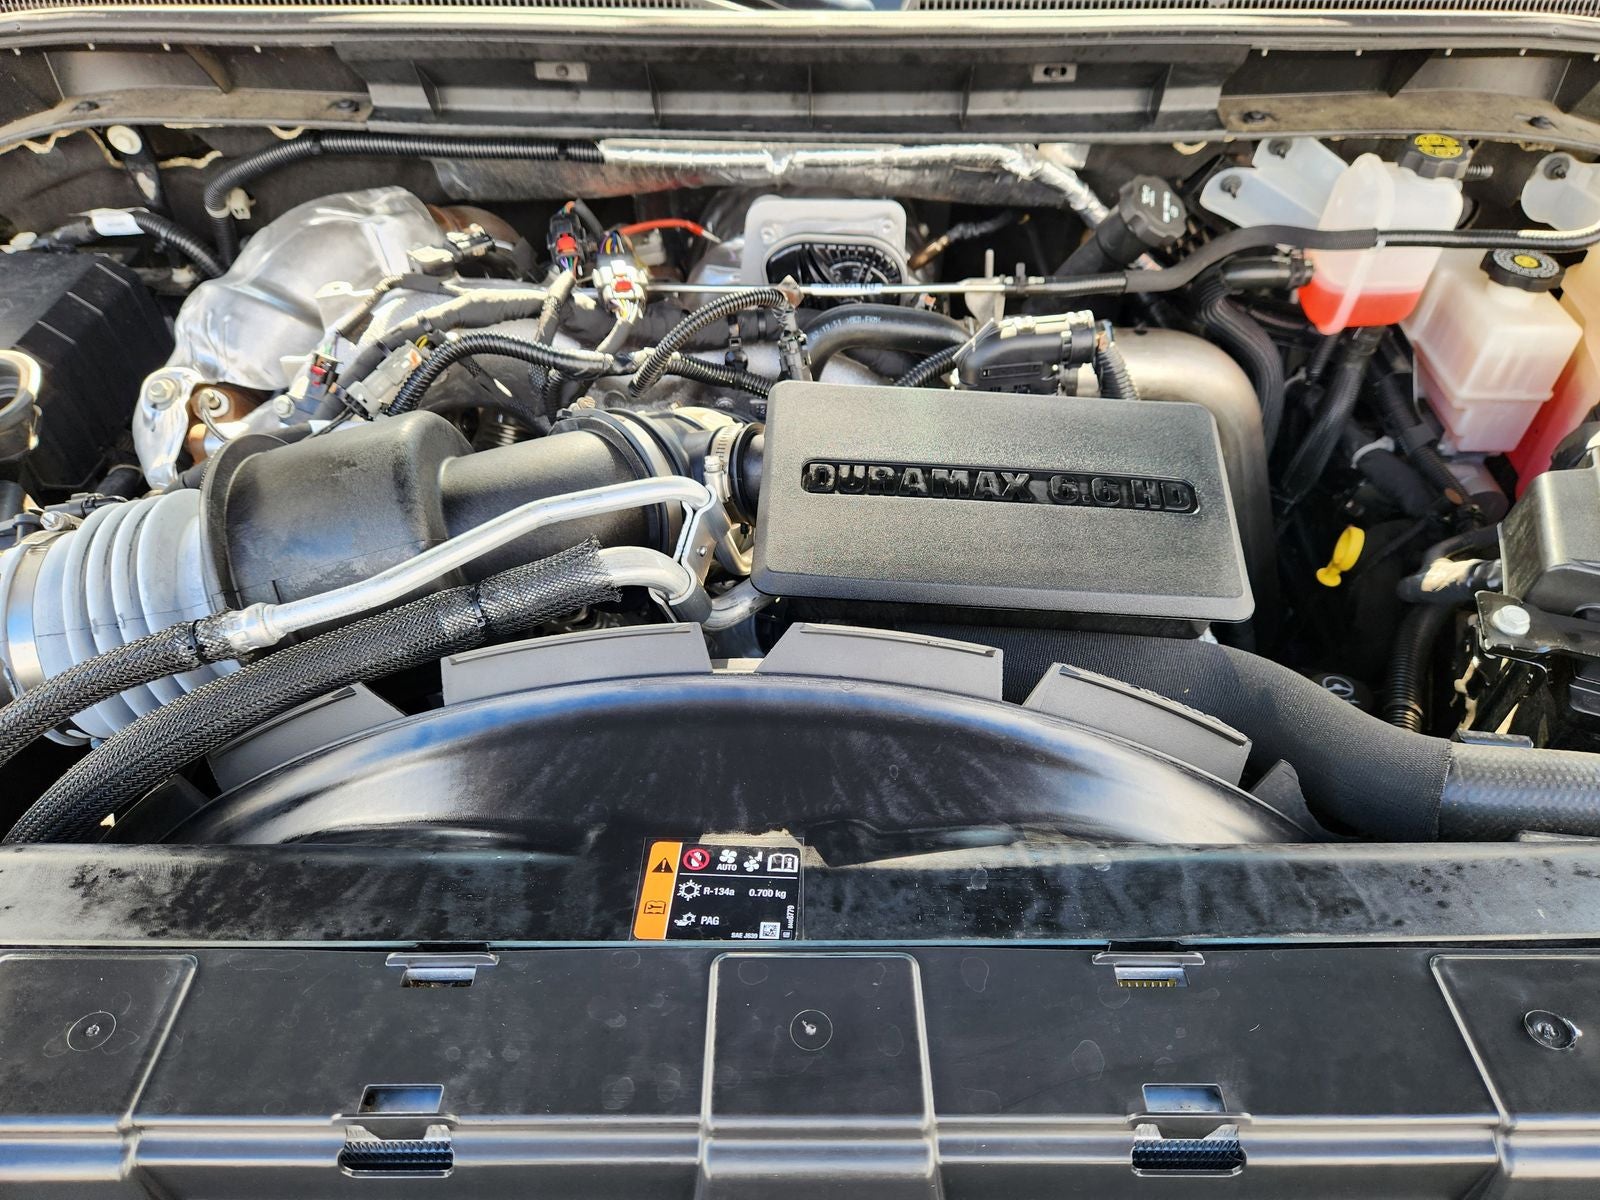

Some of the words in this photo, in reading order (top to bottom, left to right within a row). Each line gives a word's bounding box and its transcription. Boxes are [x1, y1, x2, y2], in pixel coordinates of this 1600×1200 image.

[808, 463, 1031, 500] DURAMAX
[716, 863, 737, 871] AUTO
[703, 887, 735, 896] R-134a
[748, 888, 774, 898] 0.700
[775, 888, 787, 899] kg
[700, 915, 720, 926] PAG
